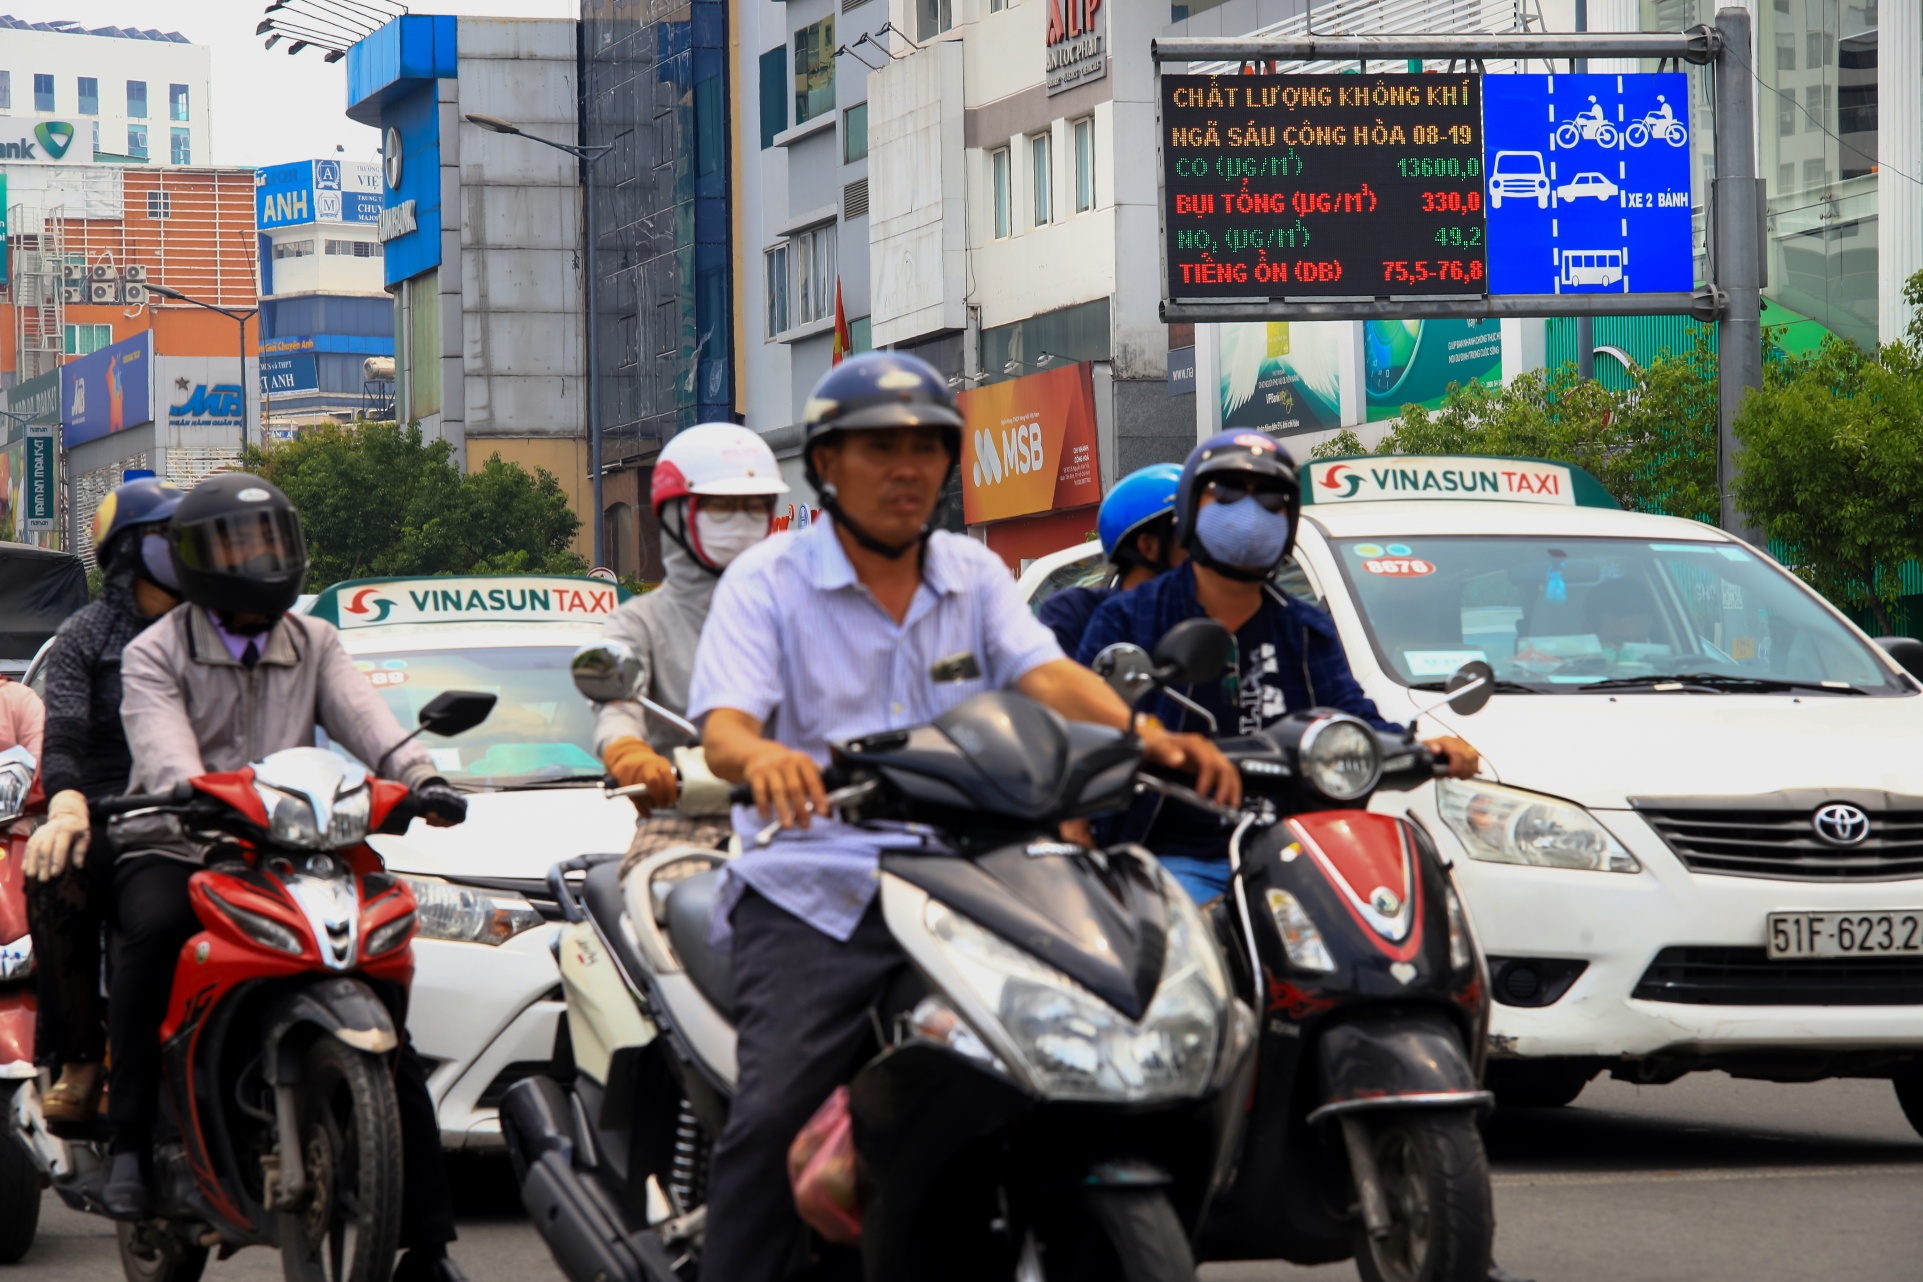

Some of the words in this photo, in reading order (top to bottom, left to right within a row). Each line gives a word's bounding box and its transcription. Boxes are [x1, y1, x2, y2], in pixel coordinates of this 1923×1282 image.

[1173, 75, 1238, 107] CHẤT
[1246, 85, 1332, 111] LƯỢNG
[1339, 80, 1420, 107] KHÔNG
[1427, 79, 1470, 106] KHÍ
[1172, 120, 1221, 147] NGÃ
[1228, 120, 1275, 147] SÁU
[1353, 118, 1406, 146] HÒA
[1413, 125, 1472, 145] 08-19
[1176, 157, 1208, 177] CO
[1397, 157, 1480, 181] 13600,0
[264, 189, 308, 223] ANH
[1176, 193, 1215, 218] BỤI
[1221, 178, 1285, 213] TỔNG
[1421, 192, 1480, 215] 330,0
[1628, 192, 1643, 208] XE
[1646, 192, 1653, 208] 2
[1658, 188, 1689, 208] BÁNH
[1434, 226, 1482, 249] 49,2
[1179, 252, 1247, 283] TIẾNG
[1254, 249, 1288, 282] ỒN
[1294, 259, 1342, 282] (DB)
[1382, 260, 1483, 285] 75,5-76,8
[271, 373, 295, 389] ANH
[1002, 422, 1044, 478] MSB
[1371, 468, 1499, 493] VINASUN
[1500, 471, 1560, 495] TAXI
[1366, 559, 1429, 574] 8676
[409, 589, 551, 612] VINASUN
[551, 588, 615, 613] TAXI
[1773, 915, 1923, 953] 51F-623.2
